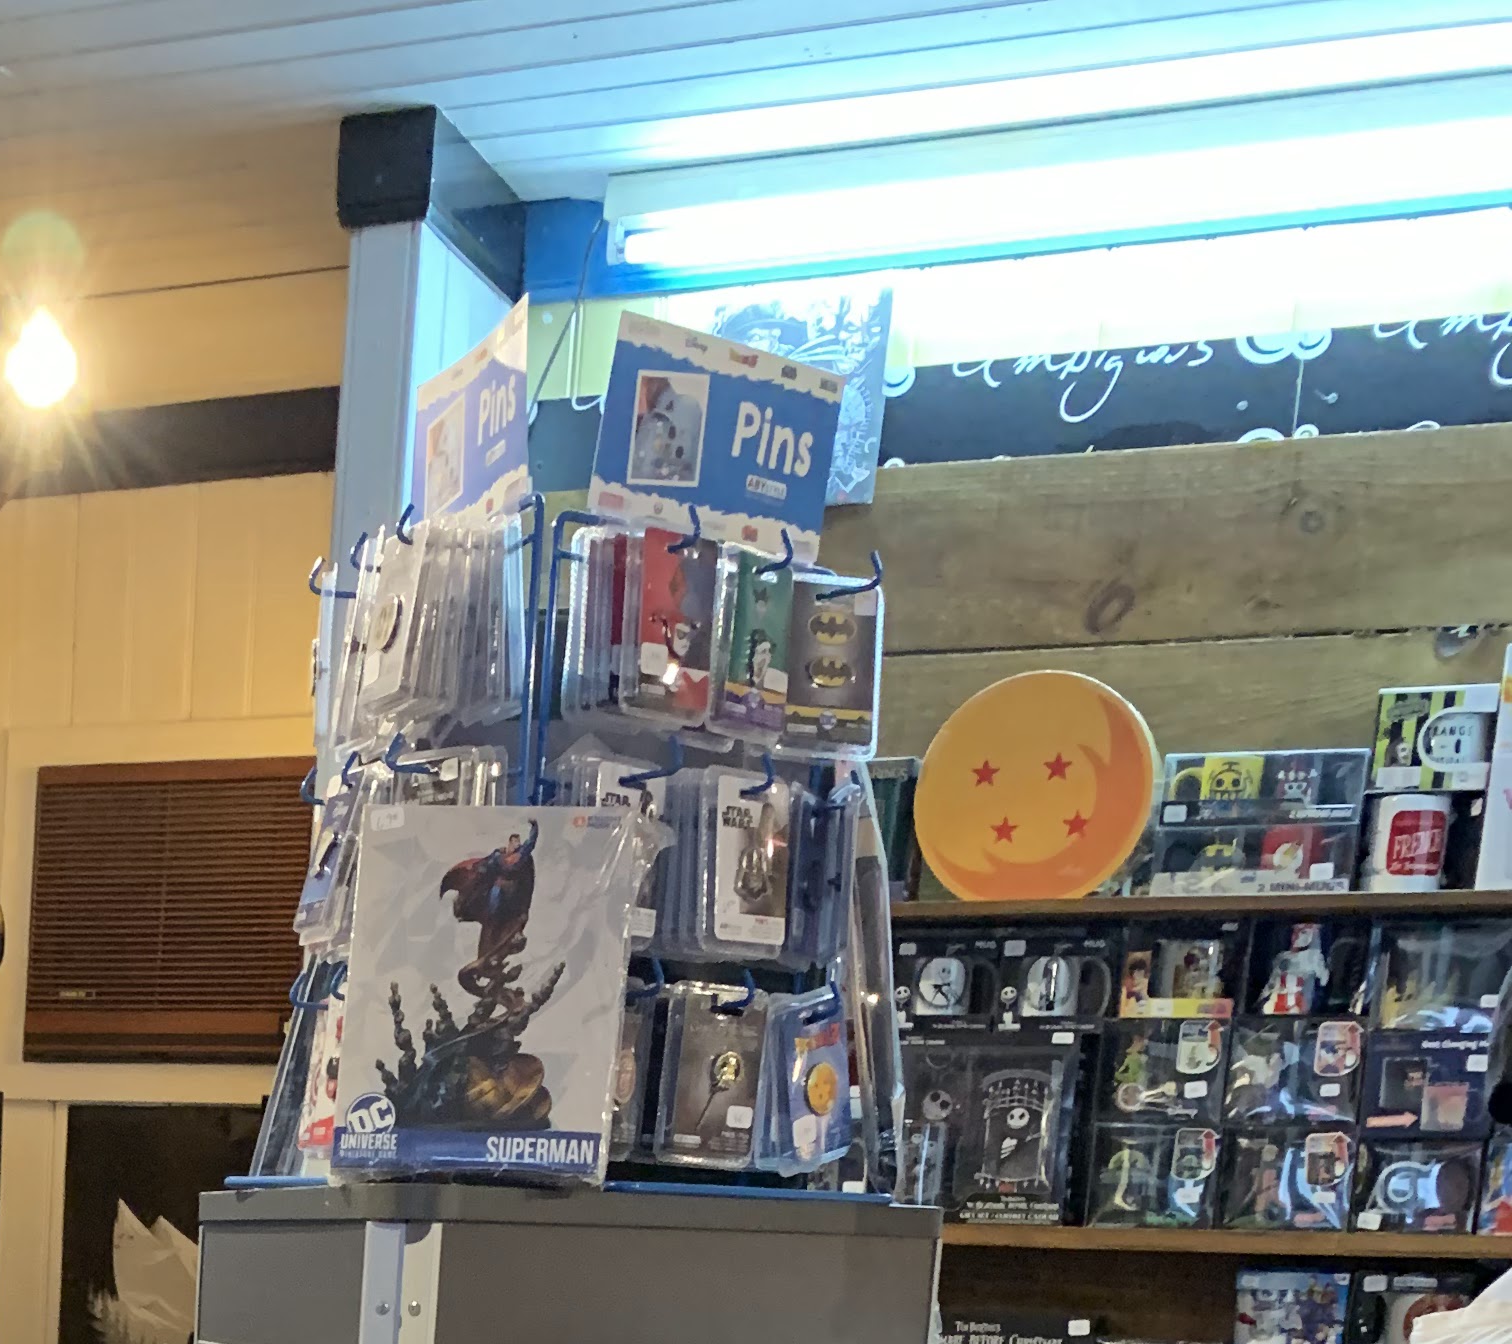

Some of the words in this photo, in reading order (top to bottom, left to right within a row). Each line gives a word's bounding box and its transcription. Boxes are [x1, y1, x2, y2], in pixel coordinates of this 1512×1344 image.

[478, 374, 516, 446] Pins
[731, 401, 813, 478] Pins
[348, 1099, 393, 1132] DC
[340, 1133, 398, 1150] UNIVERSE
[487, 1136, 593, 1164] SUPERMAN
